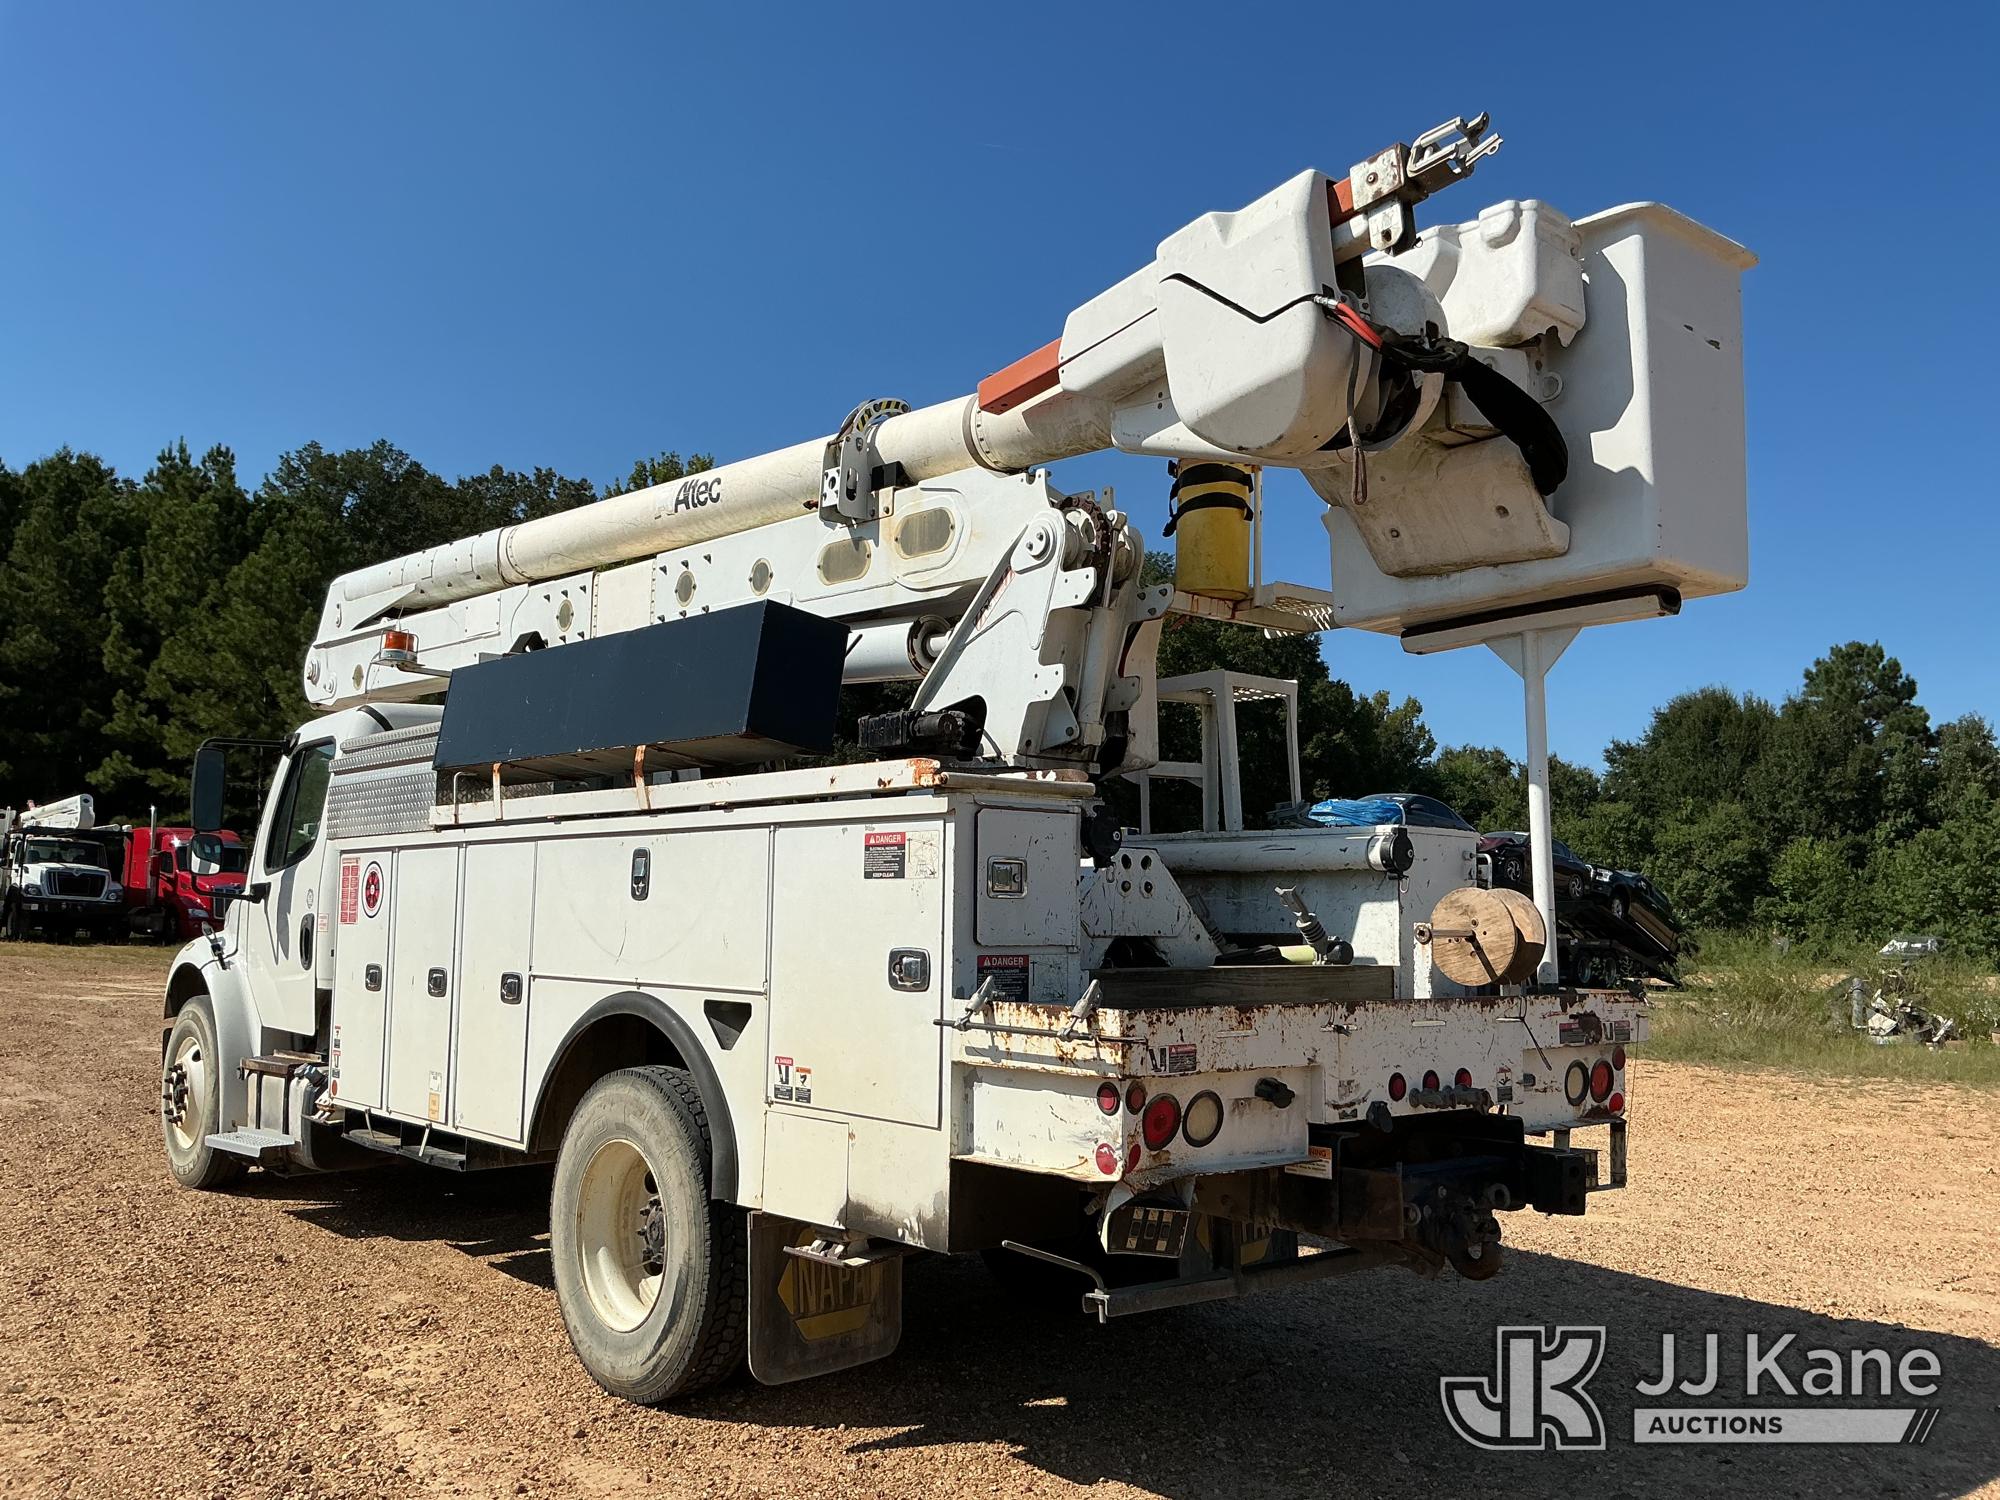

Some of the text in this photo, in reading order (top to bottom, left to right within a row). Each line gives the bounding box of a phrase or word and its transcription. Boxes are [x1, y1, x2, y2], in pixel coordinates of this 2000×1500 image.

[674, 477, 721, 513] Altec
[876, 834, 901, 844] DANGER
[992, 957, 1024, 966] DANGER
